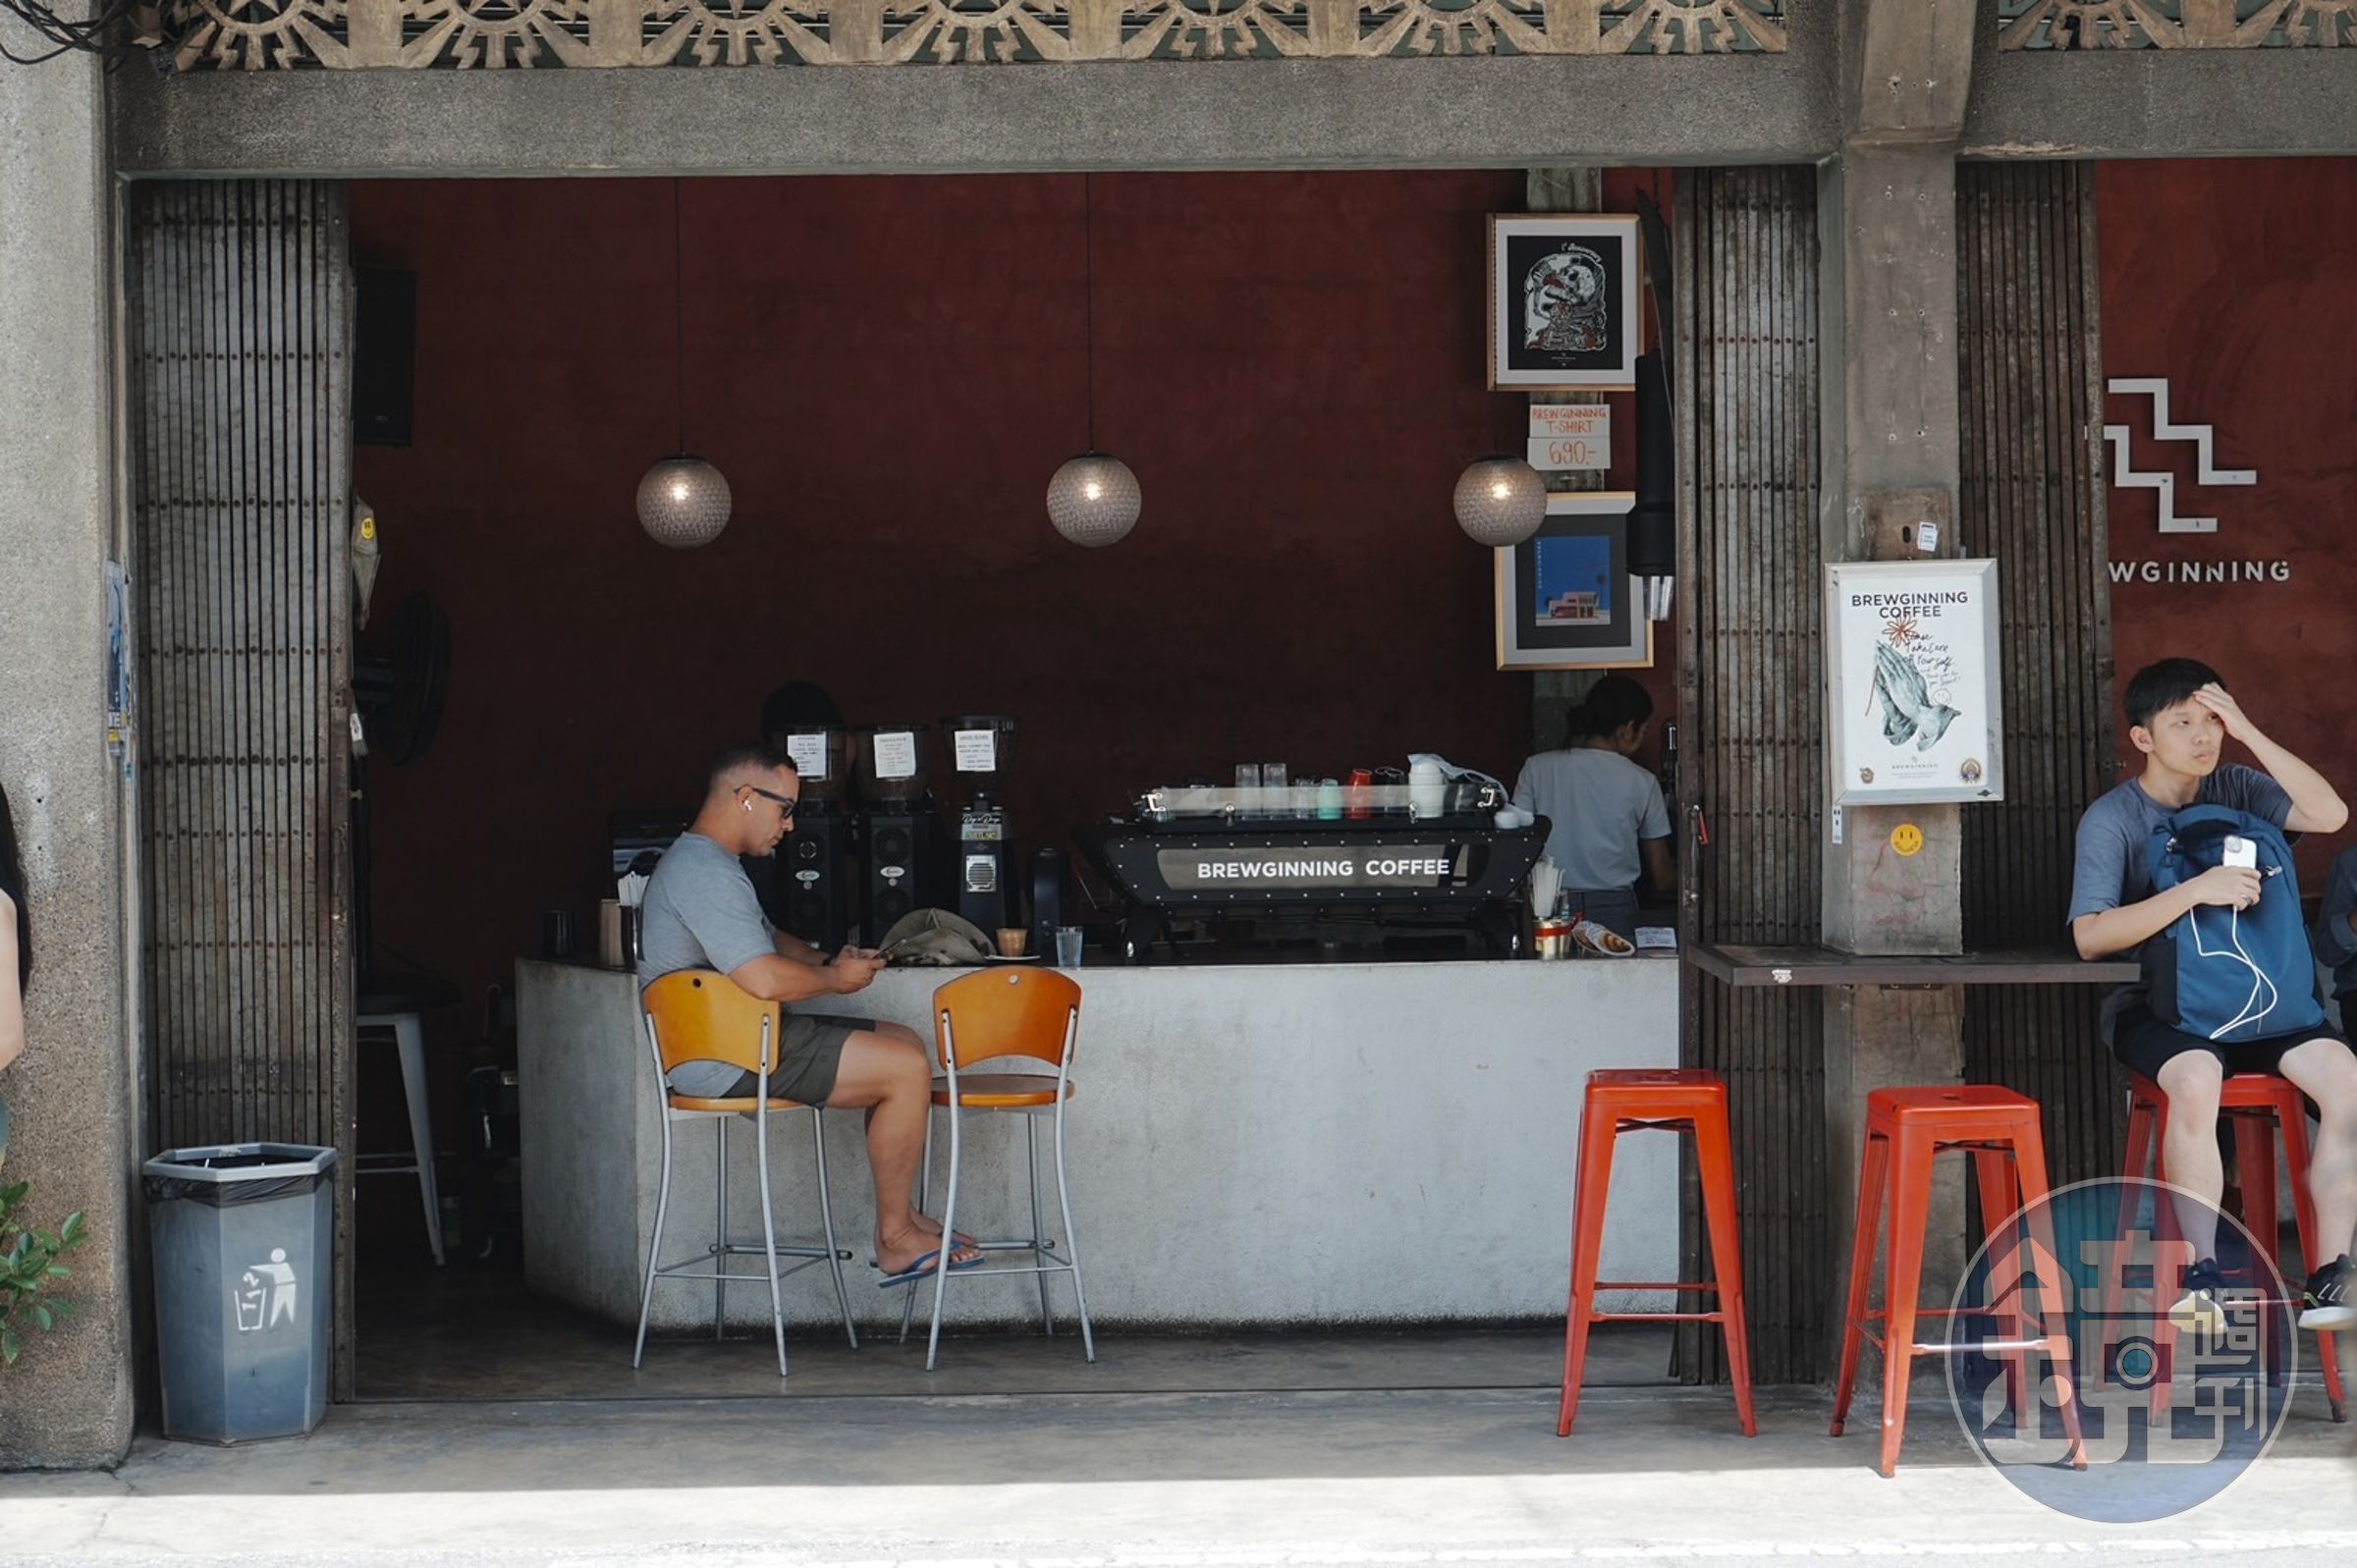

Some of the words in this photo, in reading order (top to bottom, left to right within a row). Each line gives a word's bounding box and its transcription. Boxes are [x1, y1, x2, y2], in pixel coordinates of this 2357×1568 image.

[1547, 420, 1595, 433] T-SHIRT
[1851, 591, 1968, 607] BREWGINNING
[1879, 605, 1942, 619] COFFEE
[1197, 861, 1353, 879] BREWGINNING
[1365, 859, 1450, 875] COFFEE
